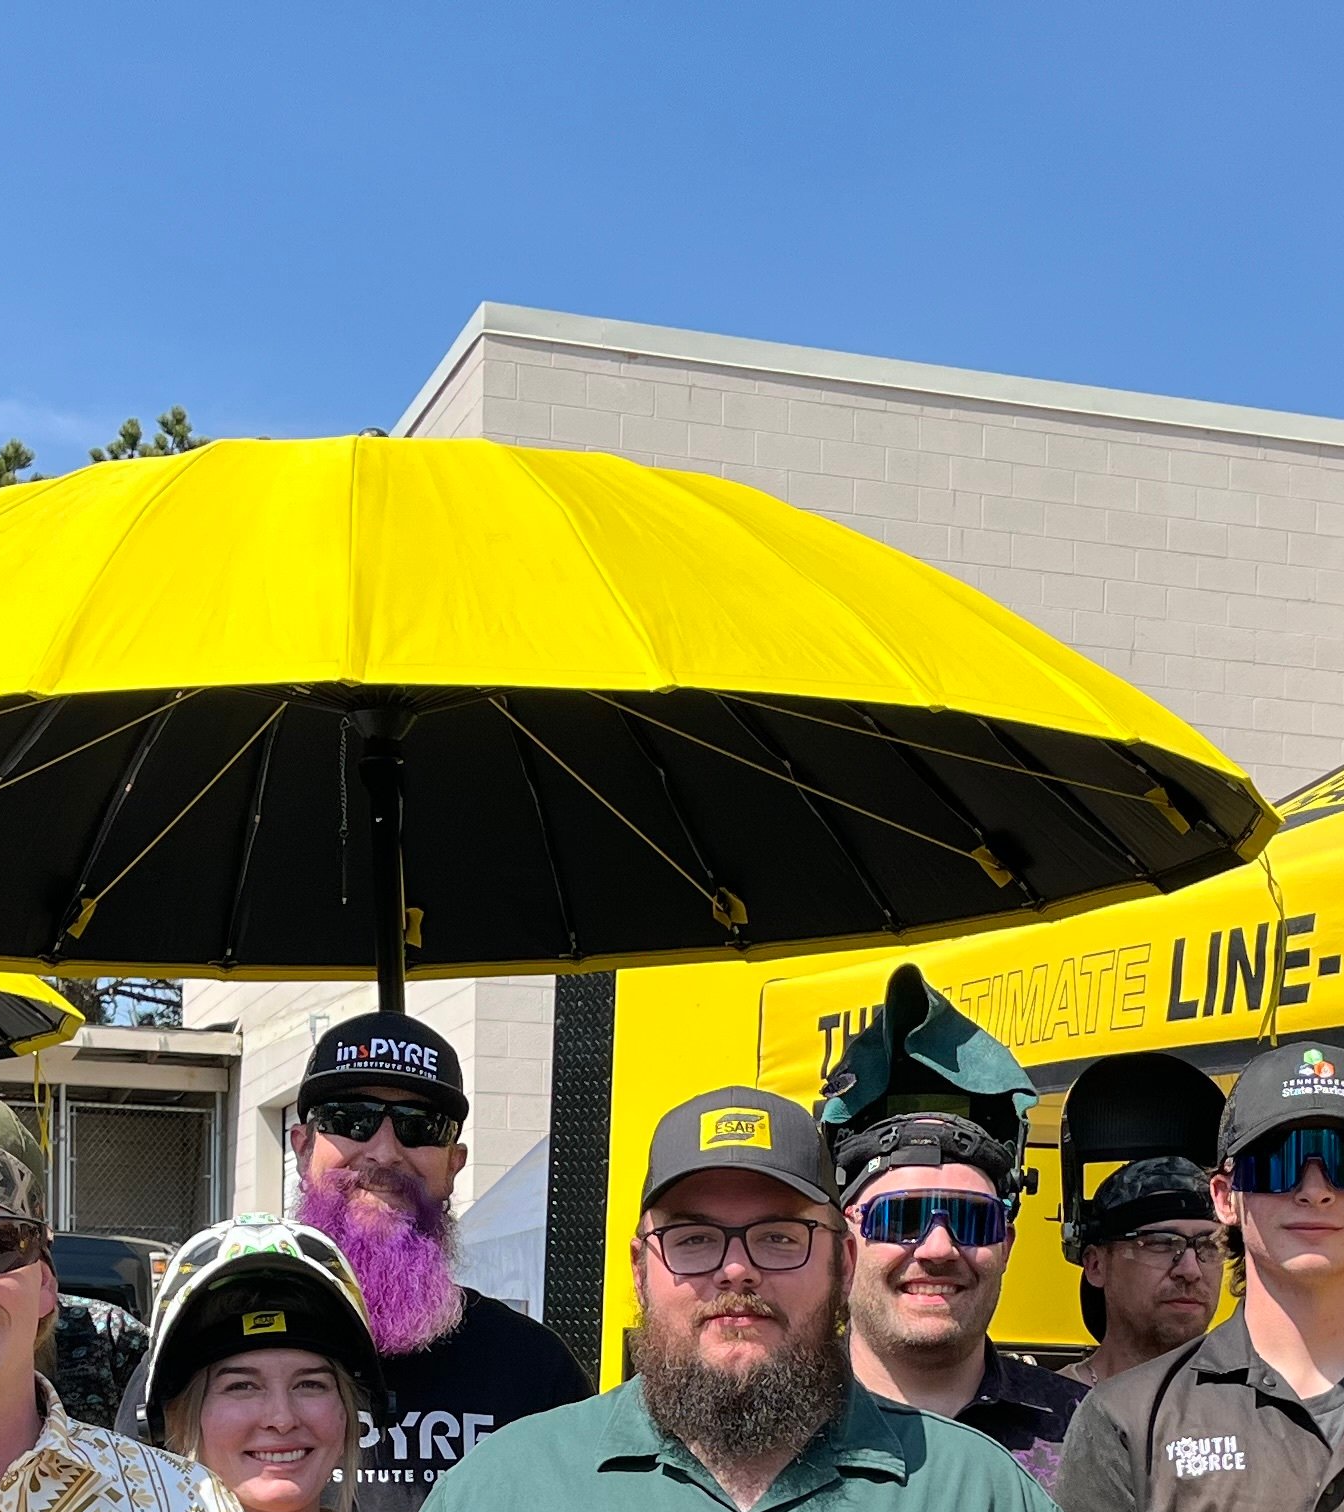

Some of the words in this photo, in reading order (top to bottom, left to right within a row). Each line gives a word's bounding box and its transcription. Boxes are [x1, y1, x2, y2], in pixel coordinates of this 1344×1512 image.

[818, 1003, 888, 1079] TH
[337, 1038, 438, 1072] insPYRE
[354, 1061, 403, 1070] INSTITUTE
[406, 1065, 417, 1073] OF
[1282, 1087, 1313, 1098] State
[716, 1121, 756, 1134] ESAB
[1165, 1435, 1237, 1461] YOUTH
[1175, 1451, 1247, 1478] FORCE
